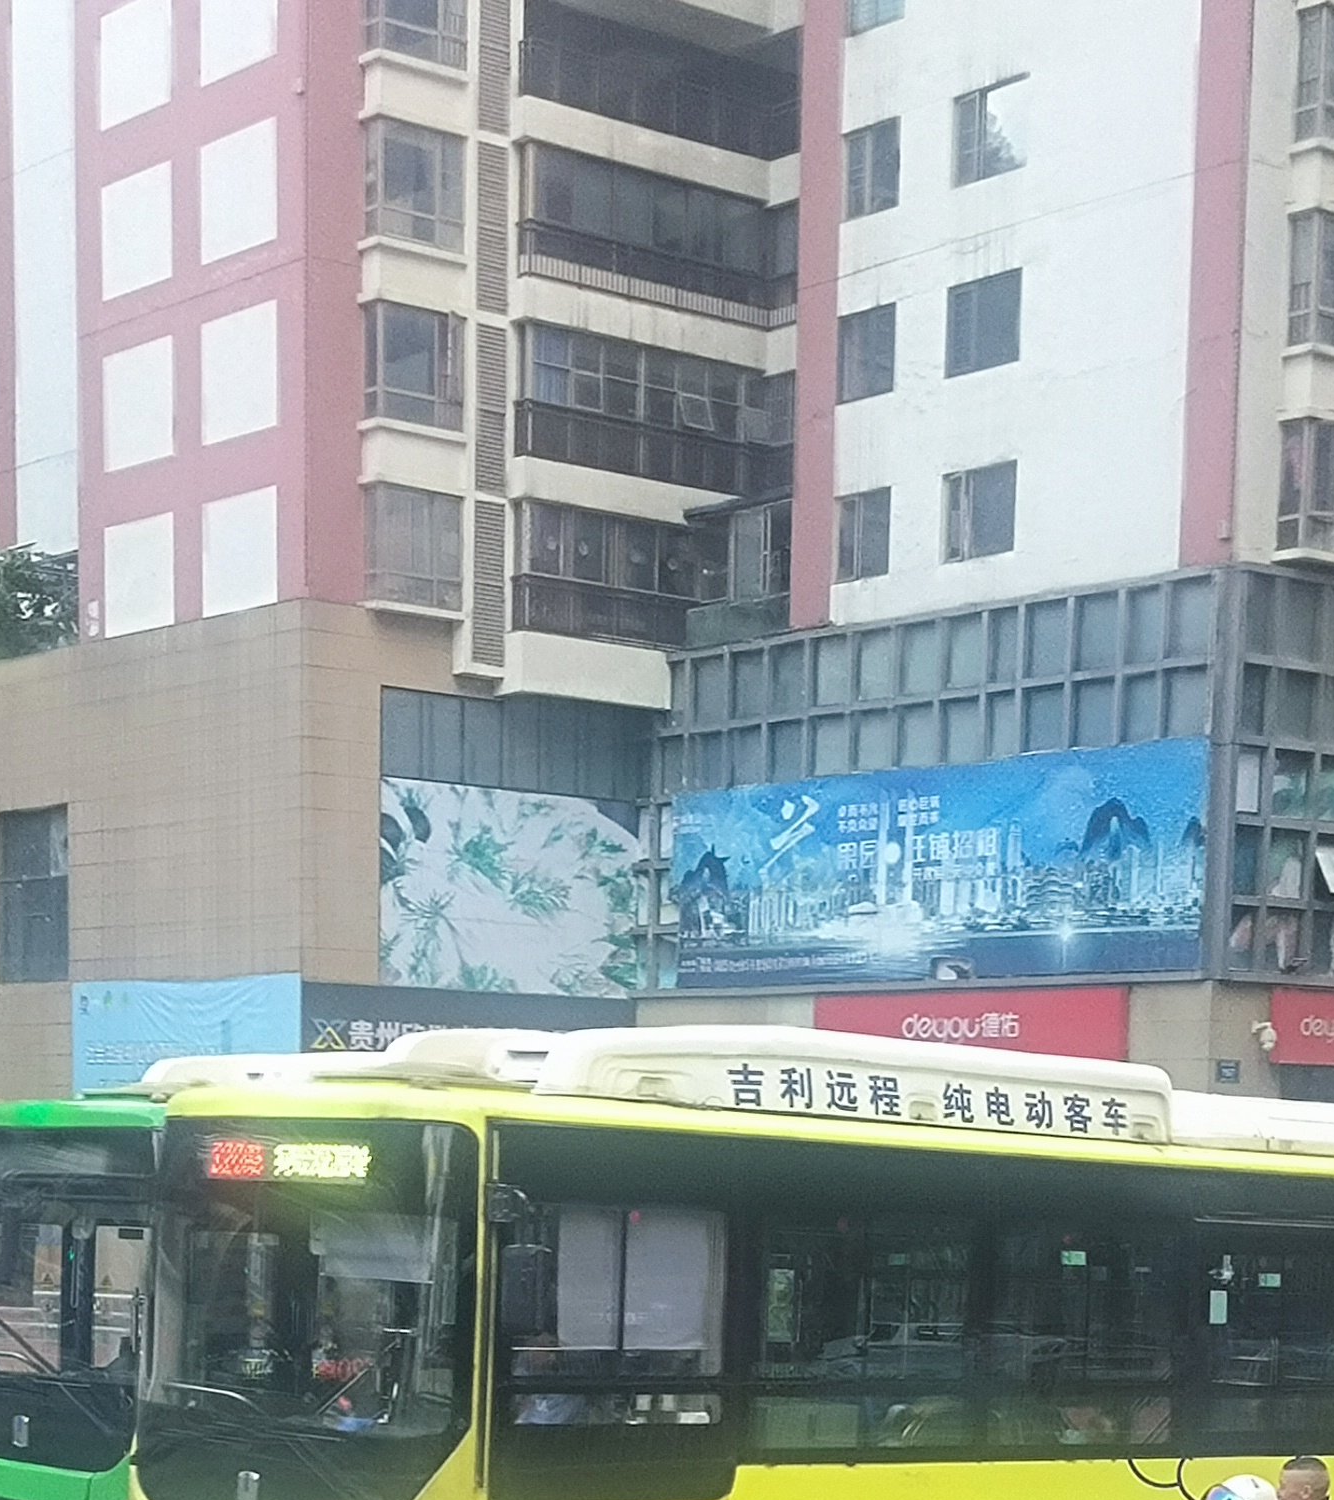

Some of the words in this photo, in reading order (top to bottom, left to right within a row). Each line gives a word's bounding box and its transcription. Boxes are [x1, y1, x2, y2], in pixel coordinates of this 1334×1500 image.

[726, 1062, 902, 1117] 吉利远程
[942, 1082, 1130, 1137] 纯电动客车
